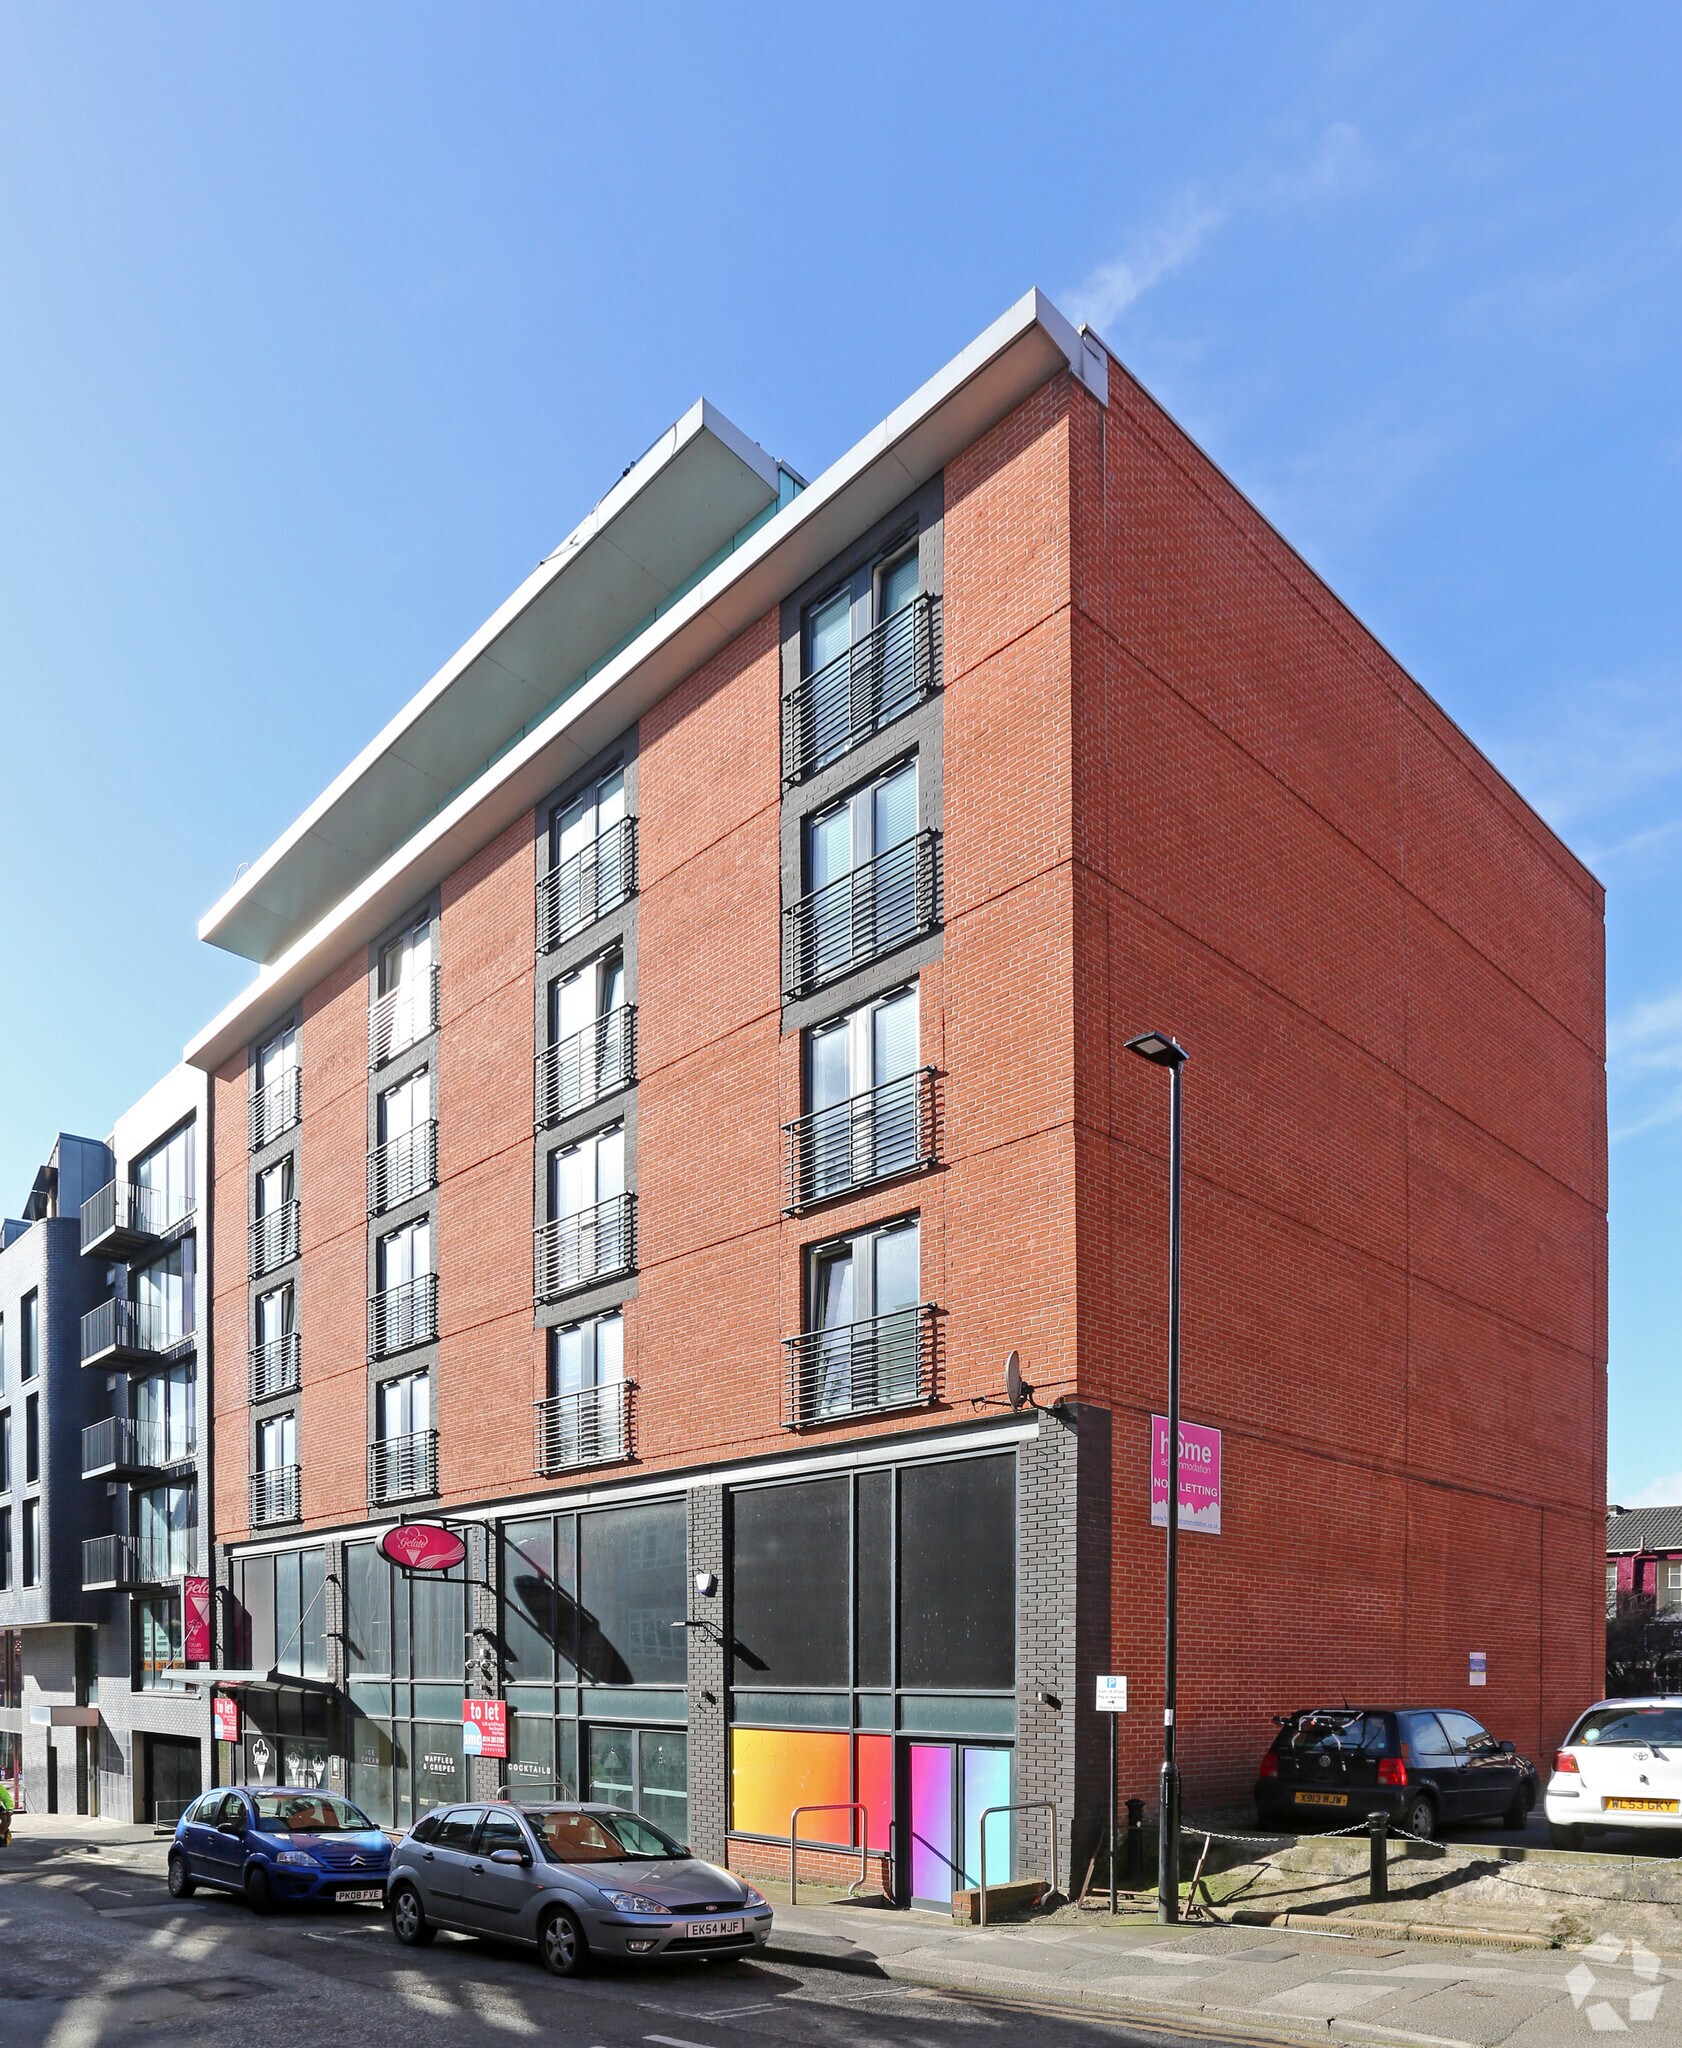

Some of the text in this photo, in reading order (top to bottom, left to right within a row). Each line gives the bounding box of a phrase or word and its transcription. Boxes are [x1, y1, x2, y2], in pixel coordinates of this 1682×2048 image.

[1160, 1458, 1211, 1475] acmmodation
[1154, 1477, 1218, 1498] NO LETTING
[398, 1538, 426, 1549] Gelato
[185, 1580, 210, 1596] Gela
[216, 1701, 233, 1714] to let
[470, 1702, 499, 1720] to let
[464, 1734, 481, 1746] smc
[361, 1756, 380, 1764] CREAM
[424, 1755, 454, 1765] WAFFLES
[429, 1764, 455, 1773] CREPES
[508, 1763, 551, 1775] COCKTAILS
[1300, 1794, 1342, 1804] X913 MJW
[1612, 1799, 1672, 1811] WL53 GKY
[339, 1891, 362, 1900] PK08
[692, 1922, 739, 1935] EK54 MJF
